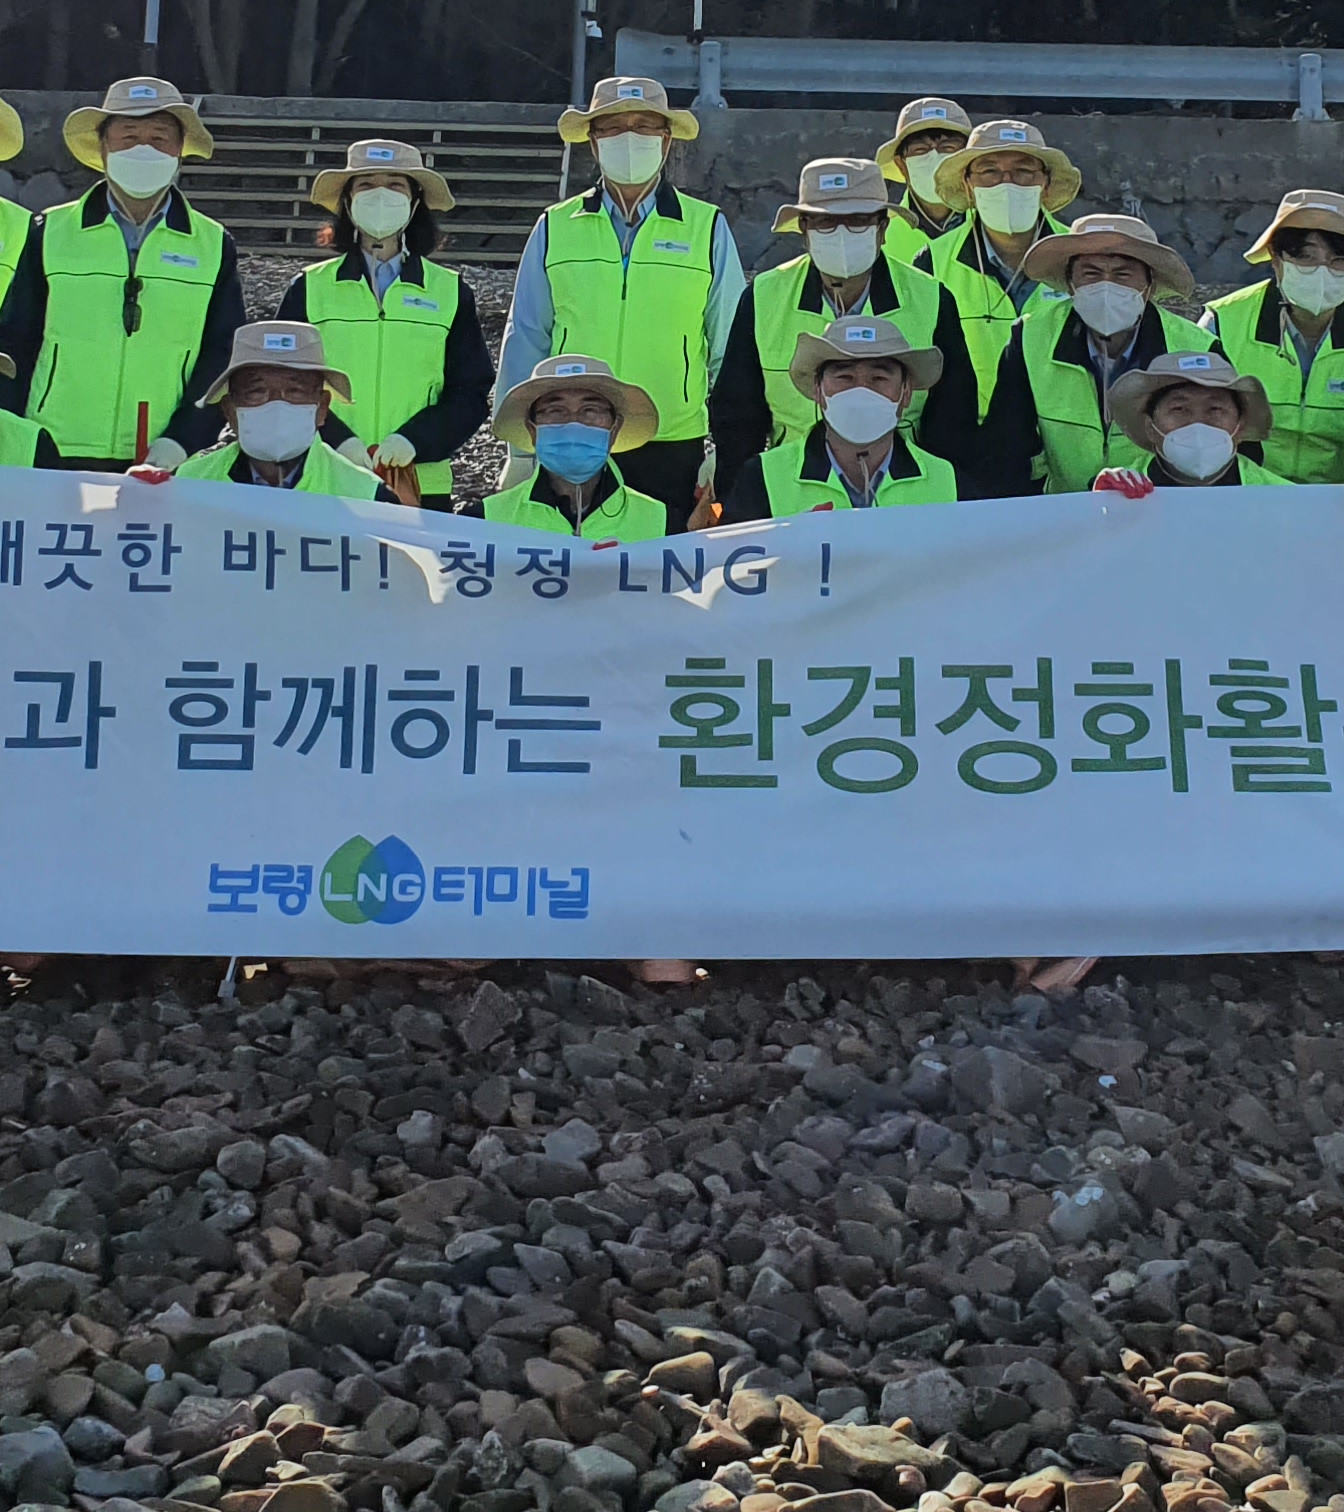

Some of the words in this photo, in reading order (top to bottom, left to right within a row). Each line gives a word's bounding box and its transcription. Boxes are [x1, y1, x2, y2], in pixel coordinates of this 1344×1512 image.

[222, 528, 391, 591] 바다!
[439, 540, 575, 600] 청정
[618, 544, 768, 595] LNG
[4, 660, 116, 770] 과
[163, 660, 602, 775] 함께하는
